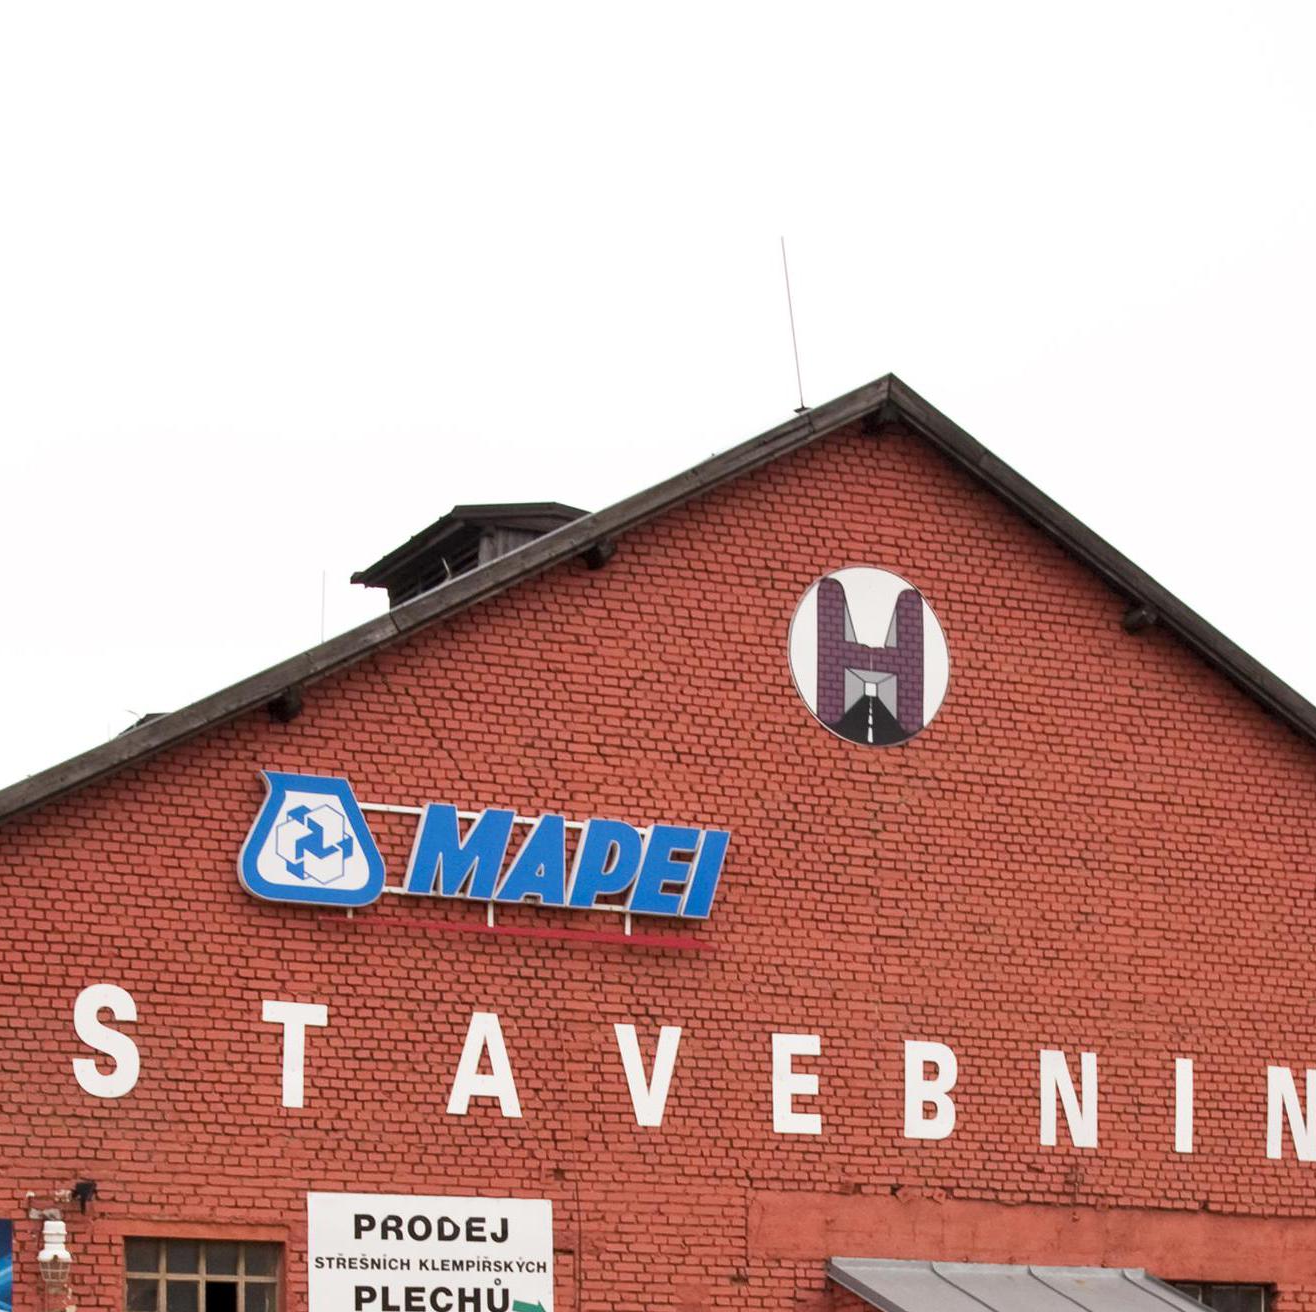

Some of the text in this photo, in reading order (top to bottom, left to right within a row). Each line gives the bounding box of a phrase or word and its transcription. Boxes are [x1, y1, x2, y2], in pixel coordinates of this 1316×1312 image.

[403, 803, 732, 919] MAPEI
[353, 1213, 509, 1243] PRODEJ
[314, 1253, 548, 1273] STŘEŠNÍCH KLEMPÍŘSKÝCH
